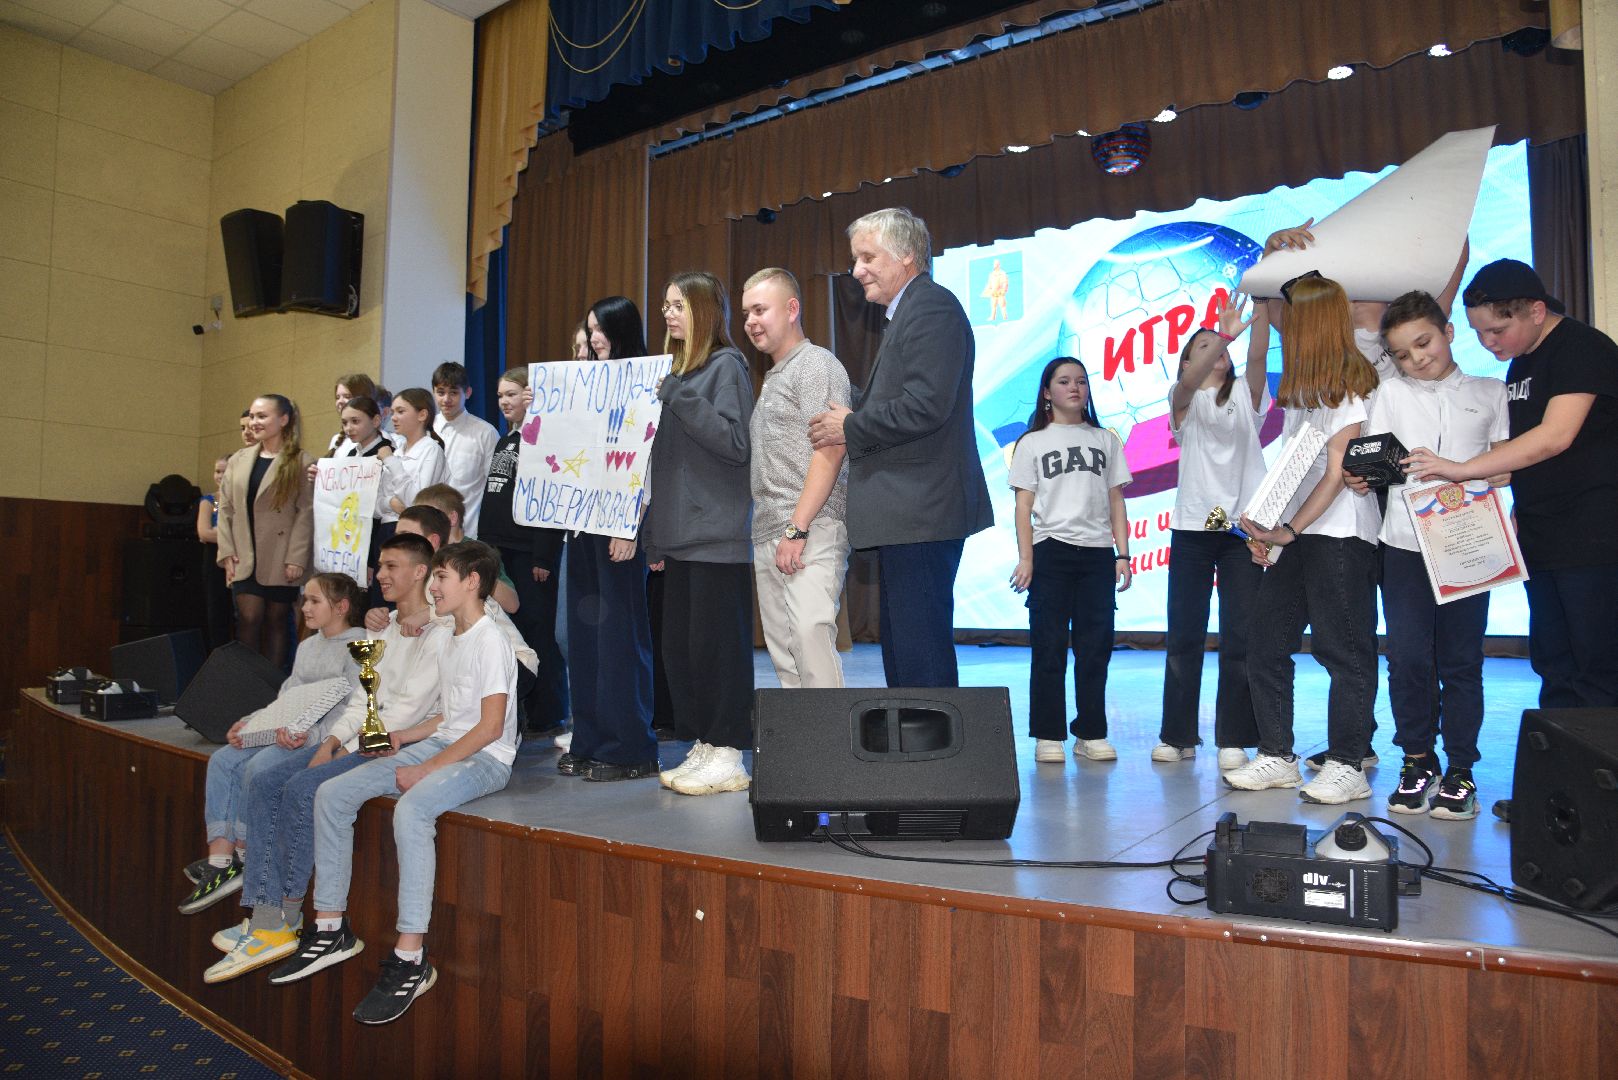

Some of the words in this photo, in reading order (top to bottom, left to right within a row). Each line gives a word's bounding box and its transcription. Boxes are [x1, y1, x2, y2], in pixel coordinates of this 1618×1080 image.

[1104, 288, 1229, 381] ИГРА
[530, 365, 568, 414] ВЫ
[1042, 446, 1106, 479] GAP
